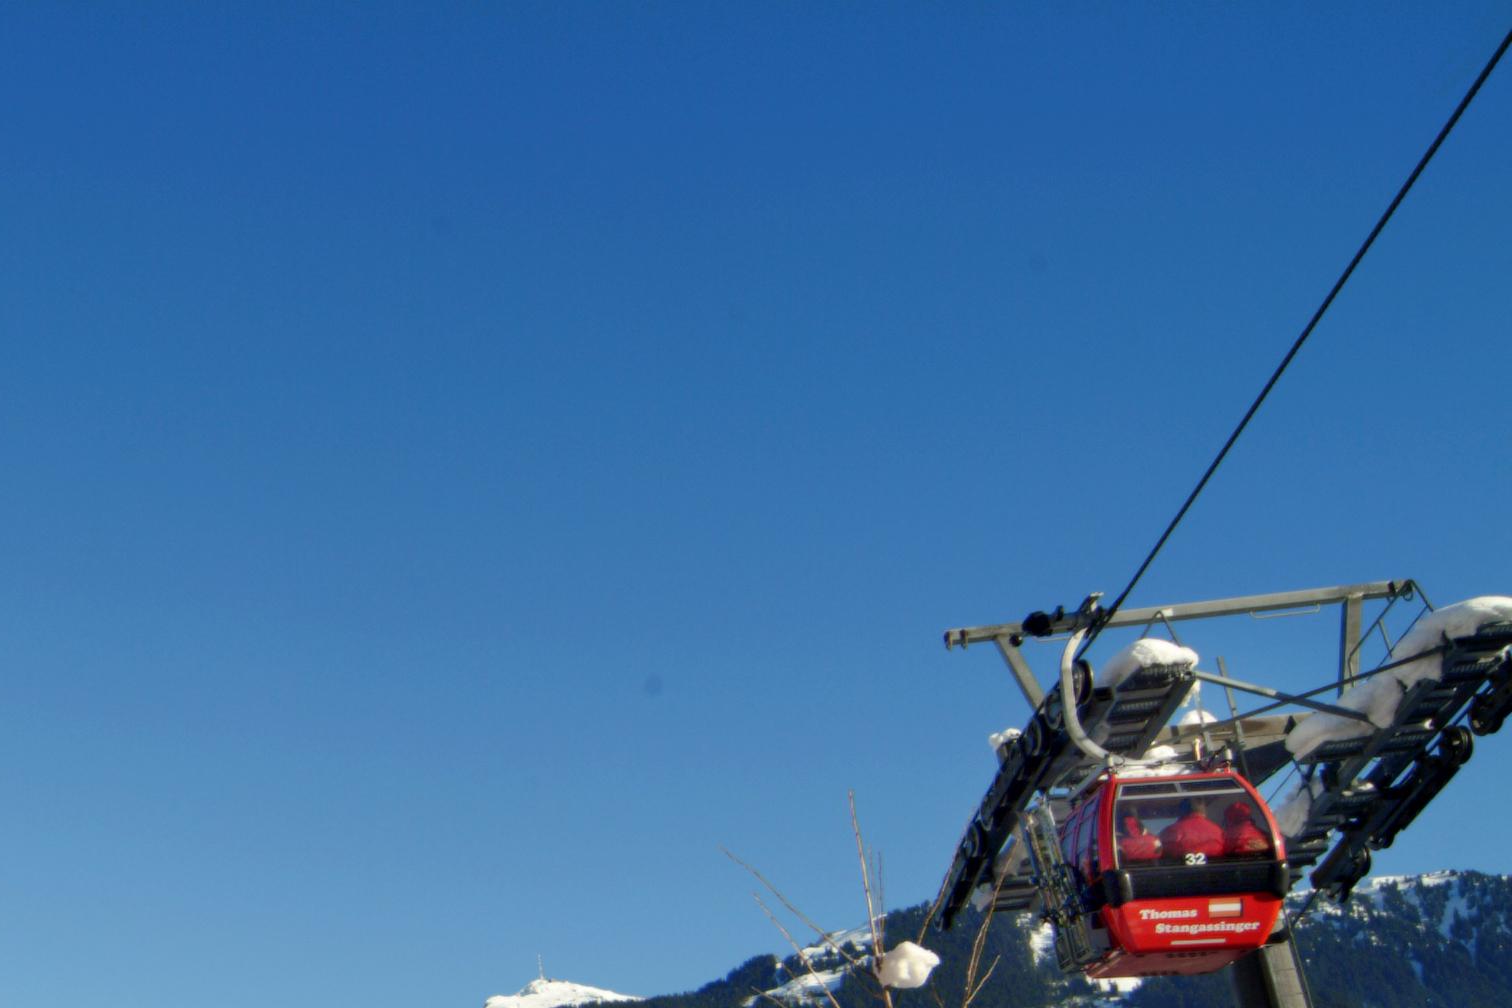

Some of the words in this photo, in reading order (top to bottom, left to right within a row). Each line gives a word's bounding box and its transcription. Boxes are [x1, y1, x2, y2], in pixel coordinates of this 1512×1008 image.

[1185, 852, 1206, 866] 32
[1139, 908, 1198, 920] Thomas
[1155, 921, 1260, 935] Stangassinger
